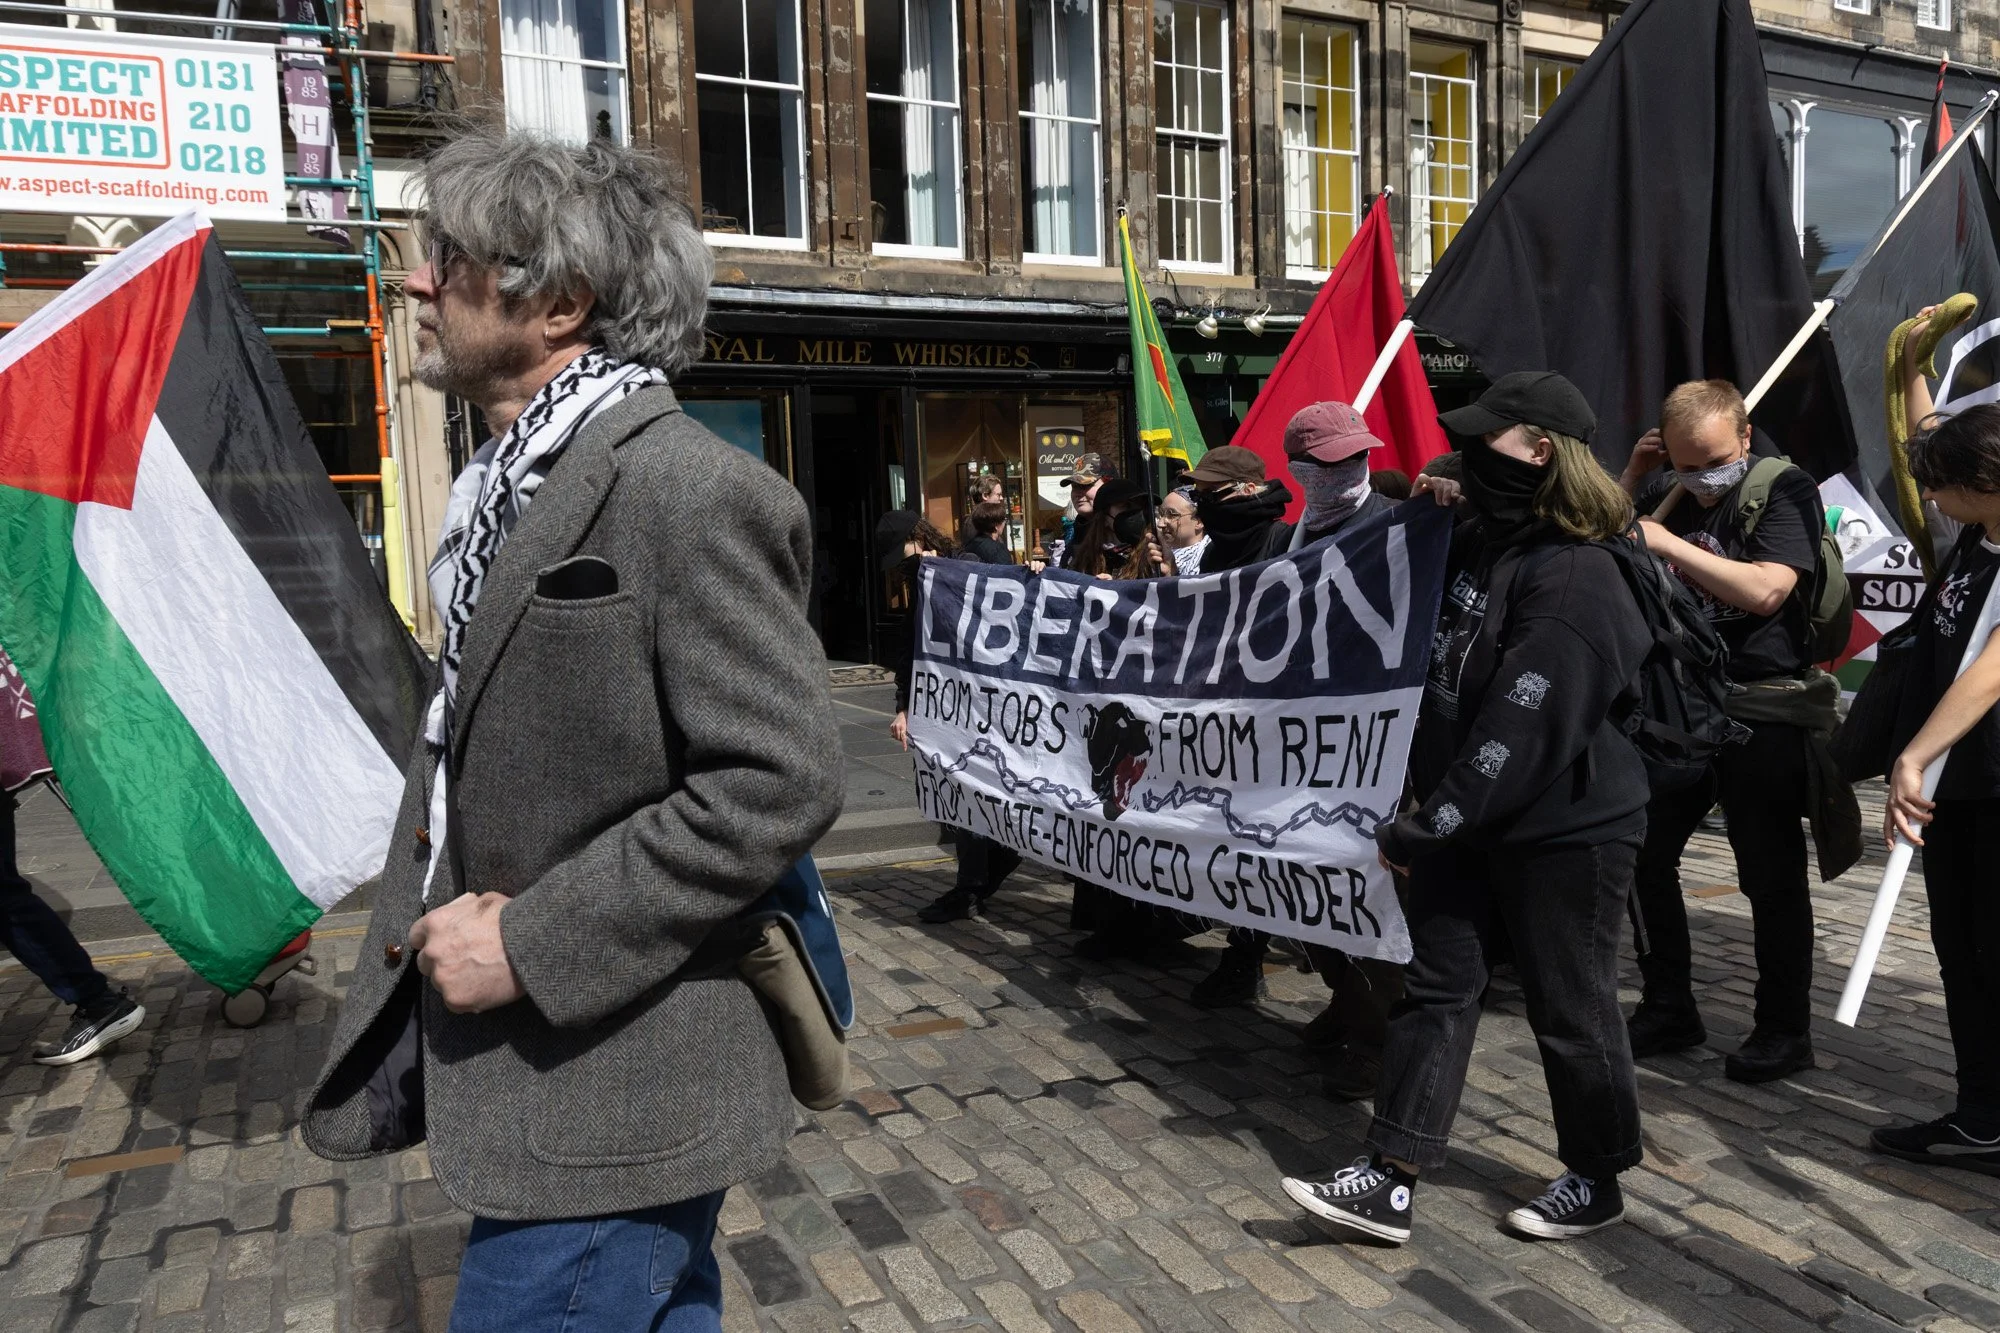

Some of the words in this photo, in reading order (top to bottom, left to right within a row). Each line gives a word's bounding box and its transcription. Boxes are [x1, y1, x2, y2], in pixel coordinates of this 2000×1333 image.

[0, 54, 151, 97] SPECT
[175, 58, 254, 91] 0131
[0, 93, 156, 122] AFFOLDING
[189, 102, 251, 133] 210
[180, 142, 266, 175] 0218
[708, 337, 775, 362] YAL
[798, 340, 872, 364] MILE
[894, 343, 1030, 367] WHISKIES
[1205, 352, 1222, 362] 377
[922, 523, 1411, 685] LIBERATION
[913, 671, 972, 728] FROM
[977, 686, 1069, 754] JOBS
[1158, 713, 1259, 783] FROM
[1280, 708, 1401, 787] RENT
[1207, 844, 1382, 938] GENDER
